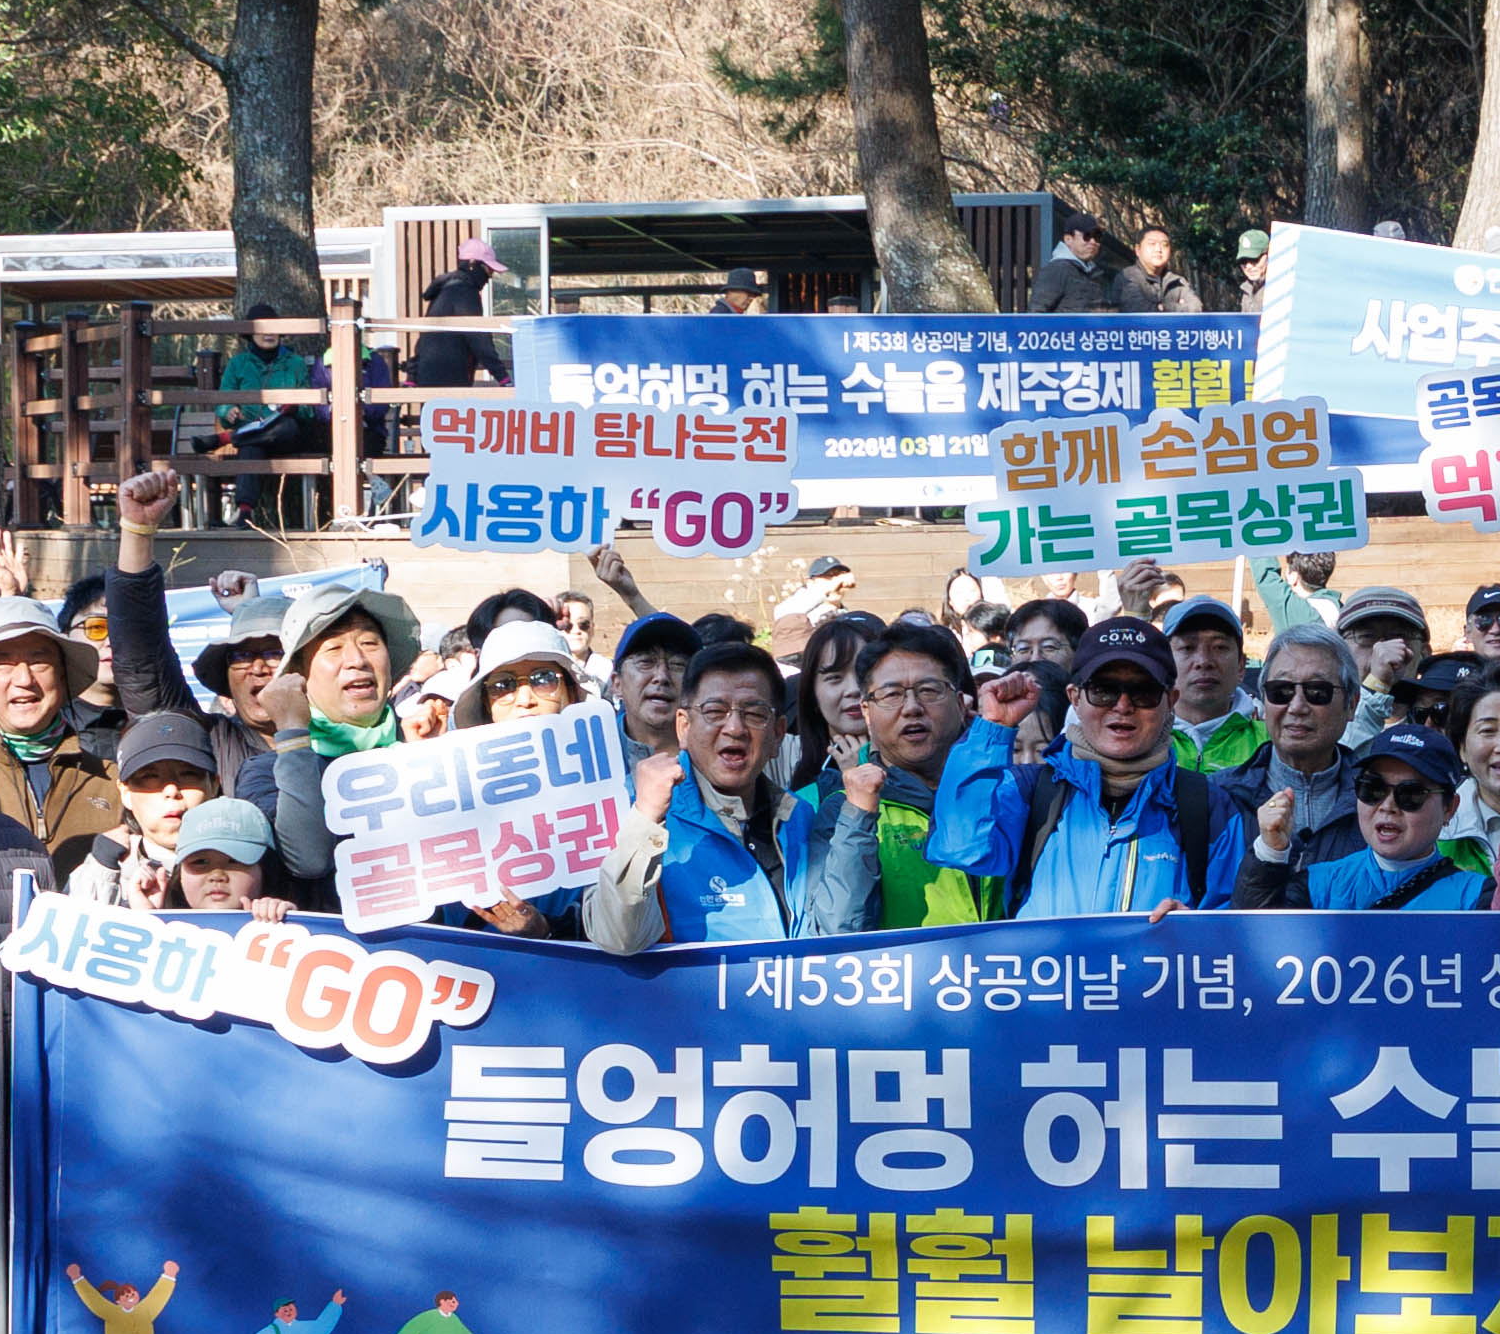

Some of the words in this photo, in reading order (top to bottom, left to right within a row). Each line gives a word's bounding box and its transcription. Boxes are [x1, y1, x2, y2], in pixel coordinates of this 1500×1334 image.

[852, 330, 908, 352] 제53회
[910, 330, 973, 353] 상공의날
[977, 330, 1013, 355] 기념,
[1018, 330, 1075, 352] 2026년
[1079, 330, 1124, 352] 상공인
[1128, 330, 1172, 351] 한마음
[1176, 329, 1234, 351] 걷기행사
[742, 363, 829, 414] 허는
[977, 360, 1141, 414] 제주경제
[1152, 359, 1231, 410] 훨훨
[432, 407, 575, 457] 먹깨비
[594, 411, 788, 463] 탐나는전
[1001, 424, 1121, 491] 함께
[1140, 408, 1320, 480] 손심엉
[421, 483, 610, 544] 사용하
[630, 487, 790, 549] “GO”
[977, 504, 1095, 566] 가는
[1115, 479, 1358, 557] 골목상권
[336, 714, 613, 831] 우리동네
[350, 796, 621, 918] 골목상권
[19, 907, 217, 1003] 사용하
[246, 933, 480, 1048] “GO”
[746, 953, 913, 1012] 제53회
[929, 954, 1124, 1014] 상공의날
[1142, 953, 1253, 1016] 기념,
[1275, 952, 1463, 1010] 2026년
[443, 1042, 974, 1192] 들엉허멍
[1021, 1044, 1284, 1190] 허는
